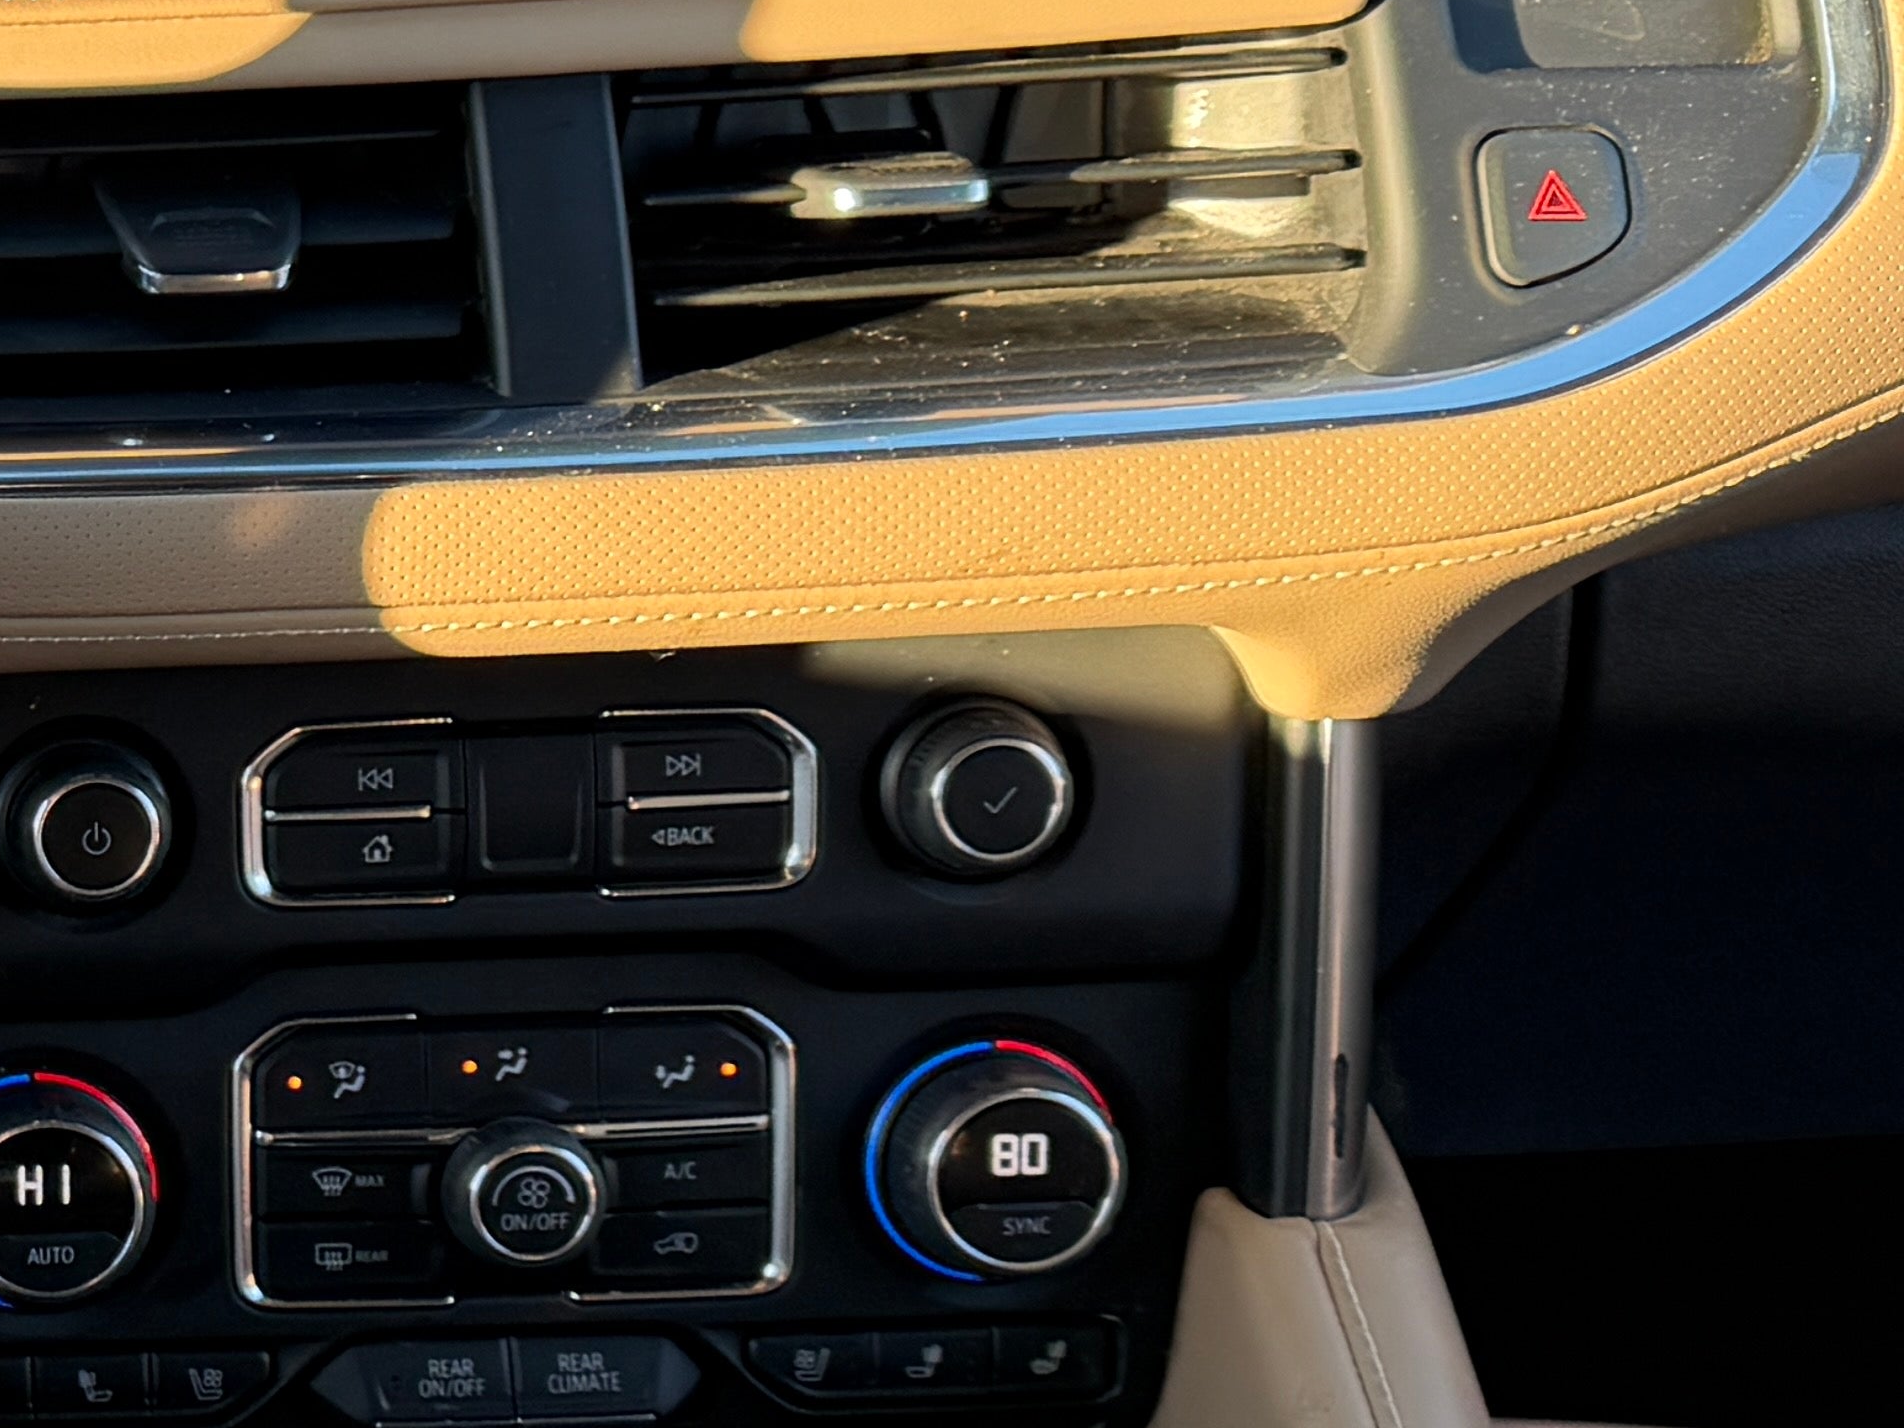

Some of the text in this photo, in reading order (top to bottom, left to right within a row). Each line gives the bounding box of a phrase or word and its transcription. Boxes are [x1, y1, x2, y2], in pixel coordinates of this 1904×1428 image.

[666, 825, 715, 847] BACK
[991, 1132, 1049, 1177] 80
[355, 1173, 386, 1188] MAX
[663, 1161, 698, 1181] A/C
[500, 1211, 571, 1233] ON/OFF
[1002, 1216, 1052, 1236] SYNC
[27, 1246, 75, 1266] AUTO
[355, 1249, 389, 1263] REAR
[428, 1358, 475, 1380] REAR
[557, 1352, 604, 1374] REAR
[418, 1376, 486, 1399] ON/OFF
[547, 1372, 622, 1394] CLIMATE
